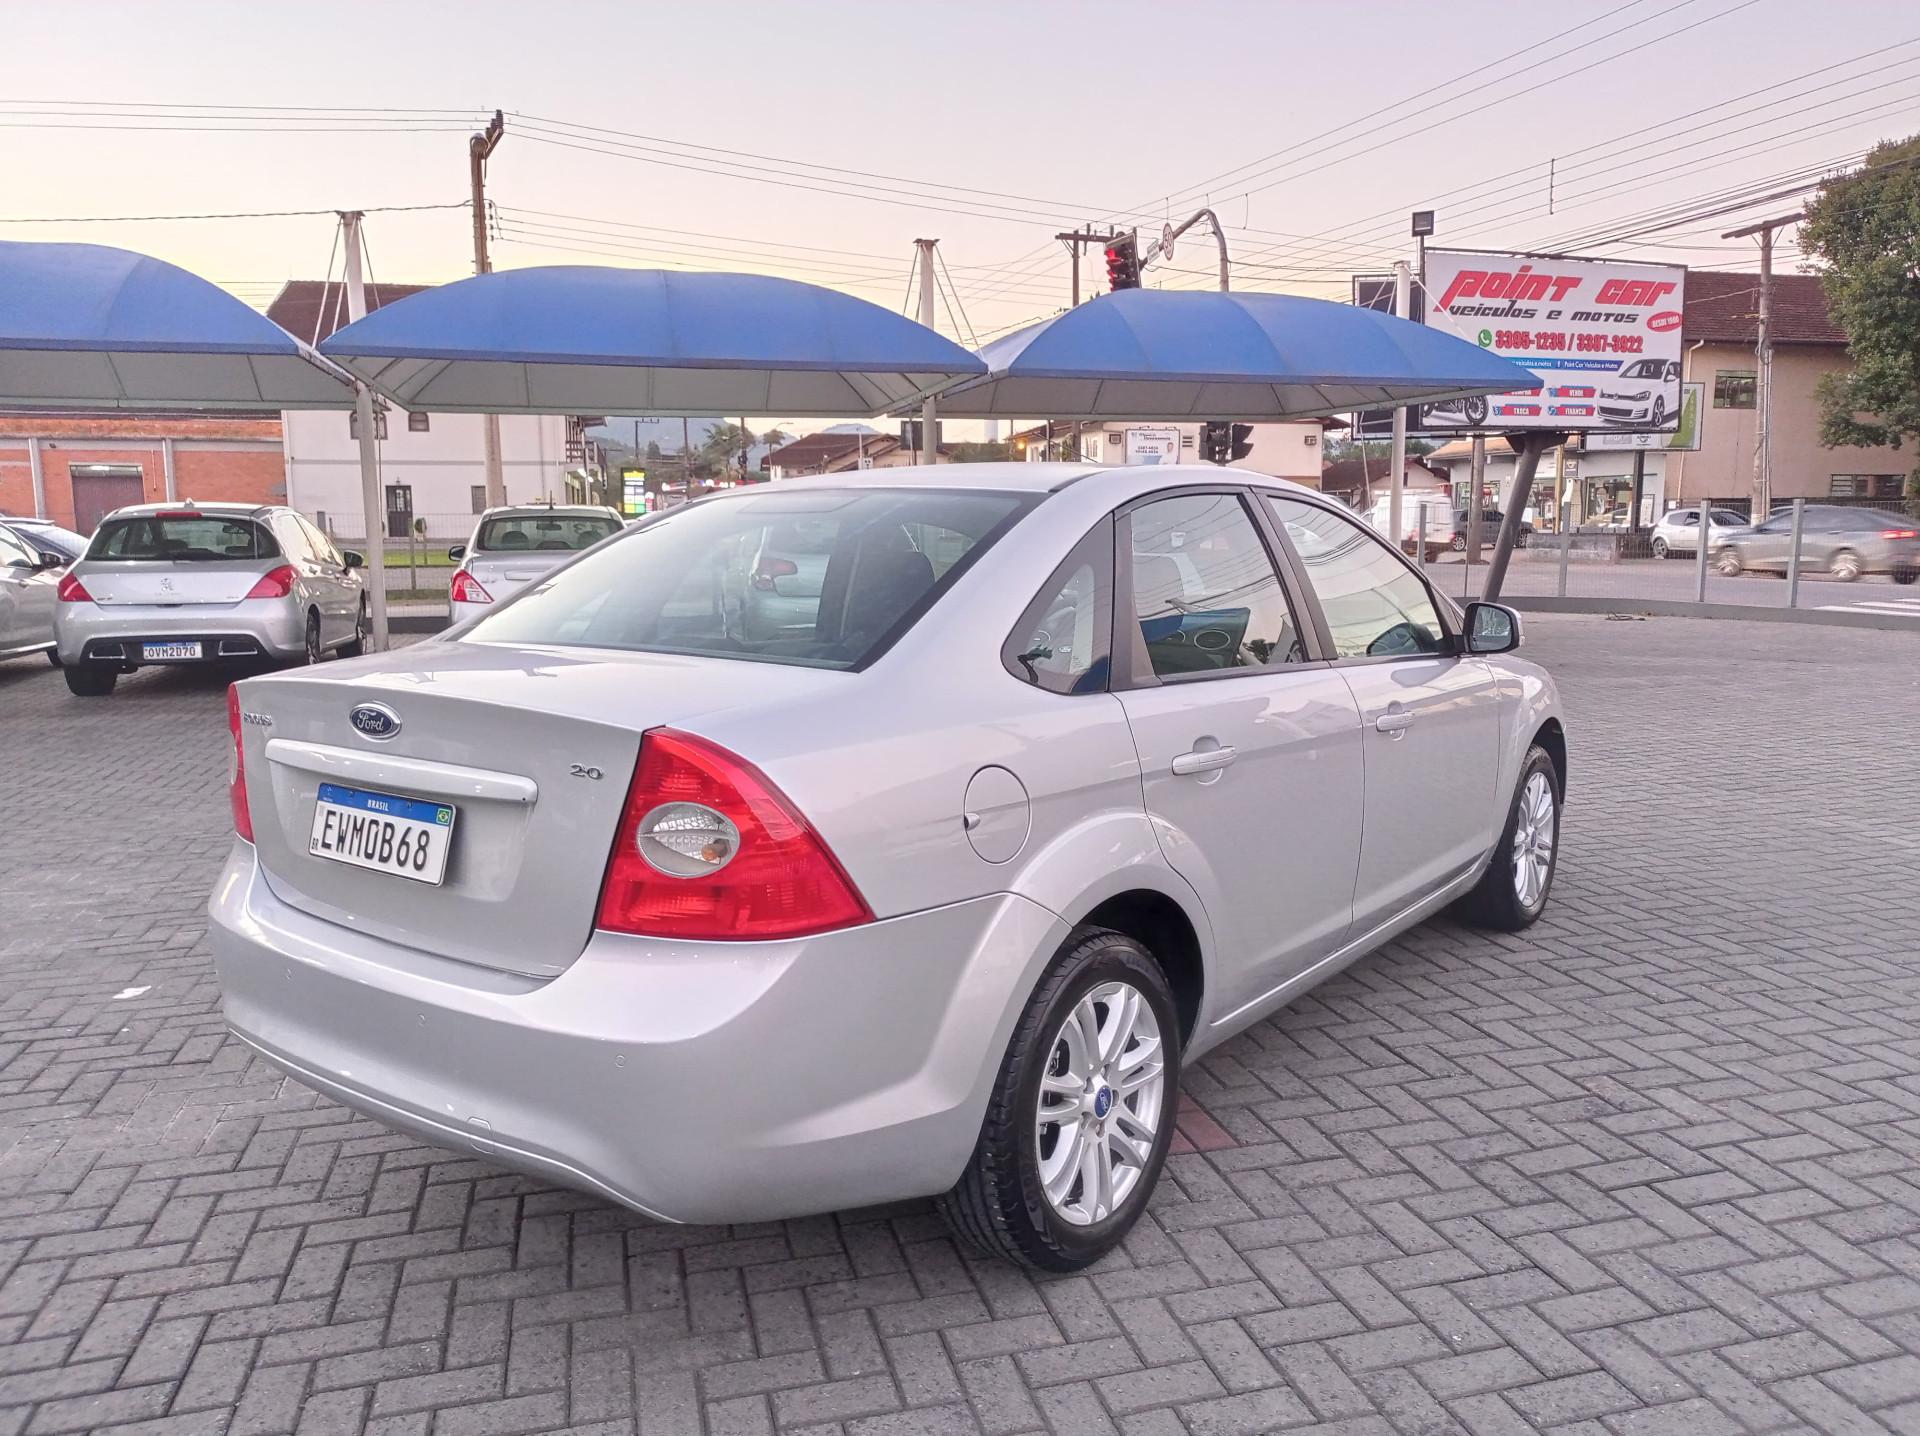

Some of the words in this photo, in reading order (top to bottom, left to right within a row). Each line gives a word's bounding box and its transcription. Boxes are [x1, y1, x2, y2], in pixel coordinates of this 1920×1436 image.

[1546, 310, 1563, 320] e
[357, 709, 384, 731] Ford
[367, 799, 390, 811] BRASIL
